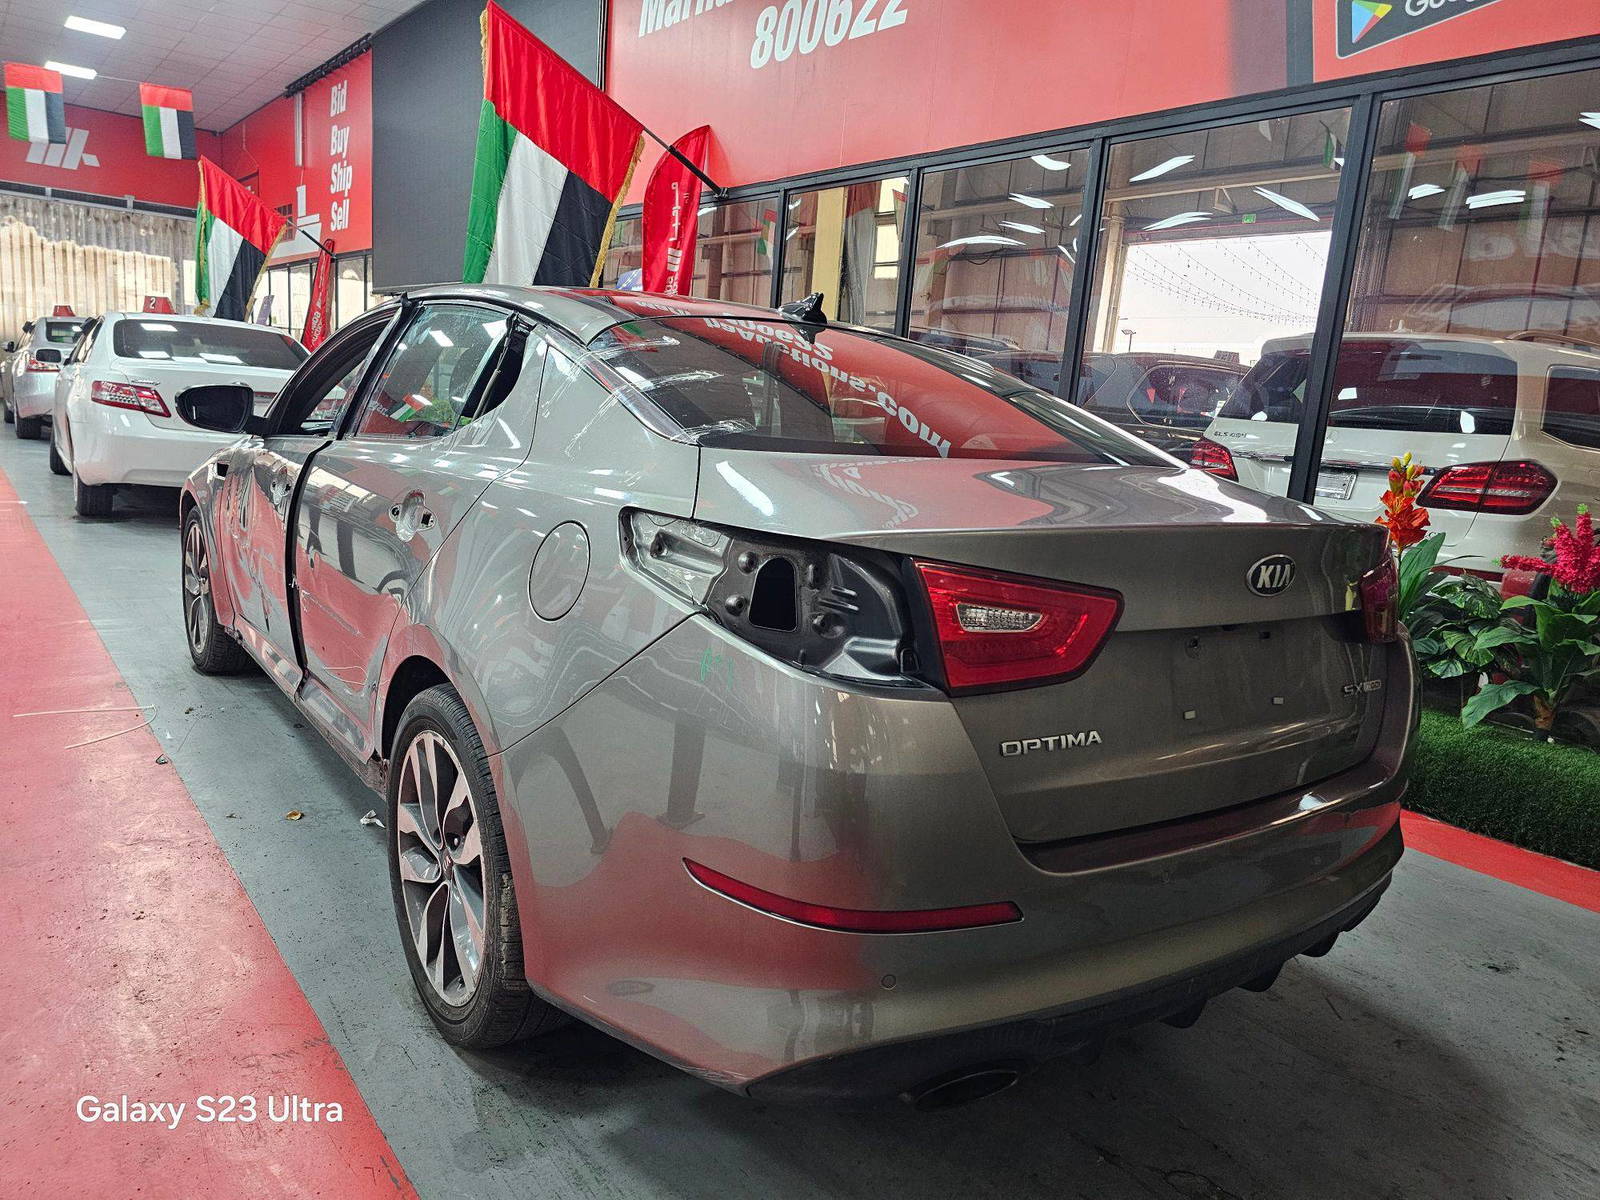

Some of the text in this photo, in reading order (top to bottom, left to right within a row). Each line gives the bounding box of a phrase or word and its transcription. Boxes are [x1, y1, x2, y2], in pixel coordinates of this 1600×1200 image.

[330, 80, 347, 117] Bid
[330, 125, 350, 158] Buy
[330, 161, 352, 197] Ship
[330, 198, 350, 232] Sell
[150, 297, 156, 310] 2
[1257, 564, 1291, 588] KIA
[1001, 730, 1102, 757] OPTIMA
